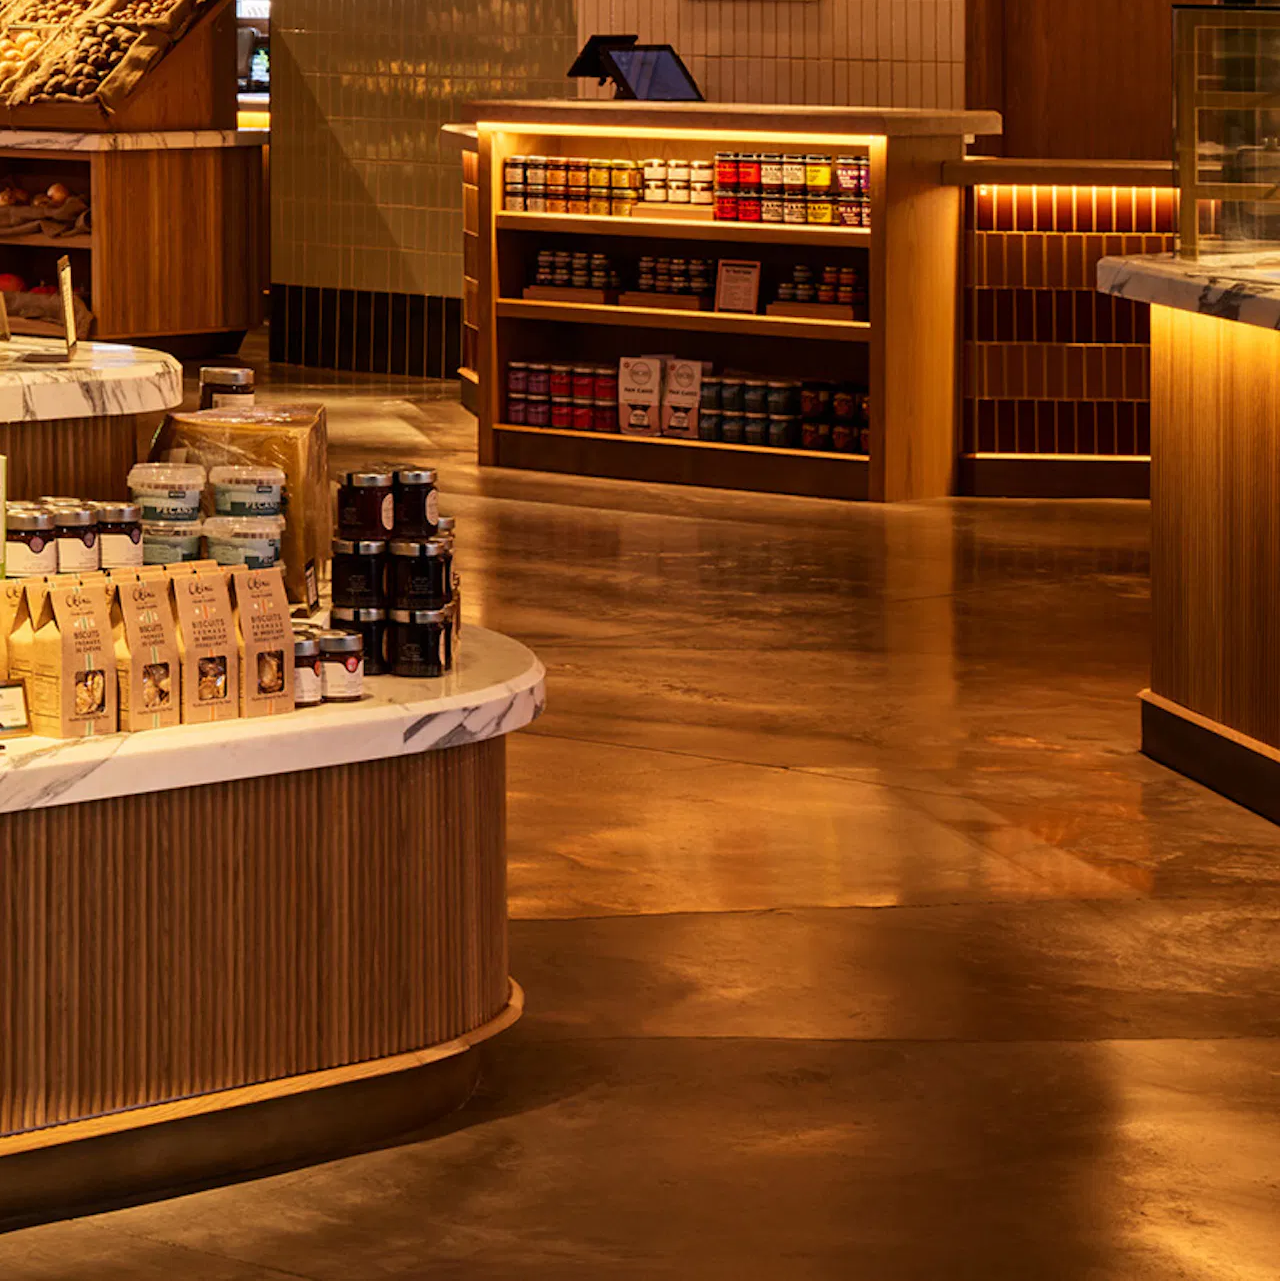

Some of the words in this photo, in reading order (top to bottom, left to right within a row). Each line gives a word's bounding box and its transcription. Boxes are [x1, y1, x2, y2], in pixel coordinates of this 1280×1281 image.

[156, 506, 193, 514] PECANS
[245, 501, 279, 510] PECANS
[251, 613, 282, 623] BISCUITS
[139, 623, 163, 632] BISCUITS
[192, 618, 225, 628] BISCUITS
[74, 630, 100, 639] BISCUITS
